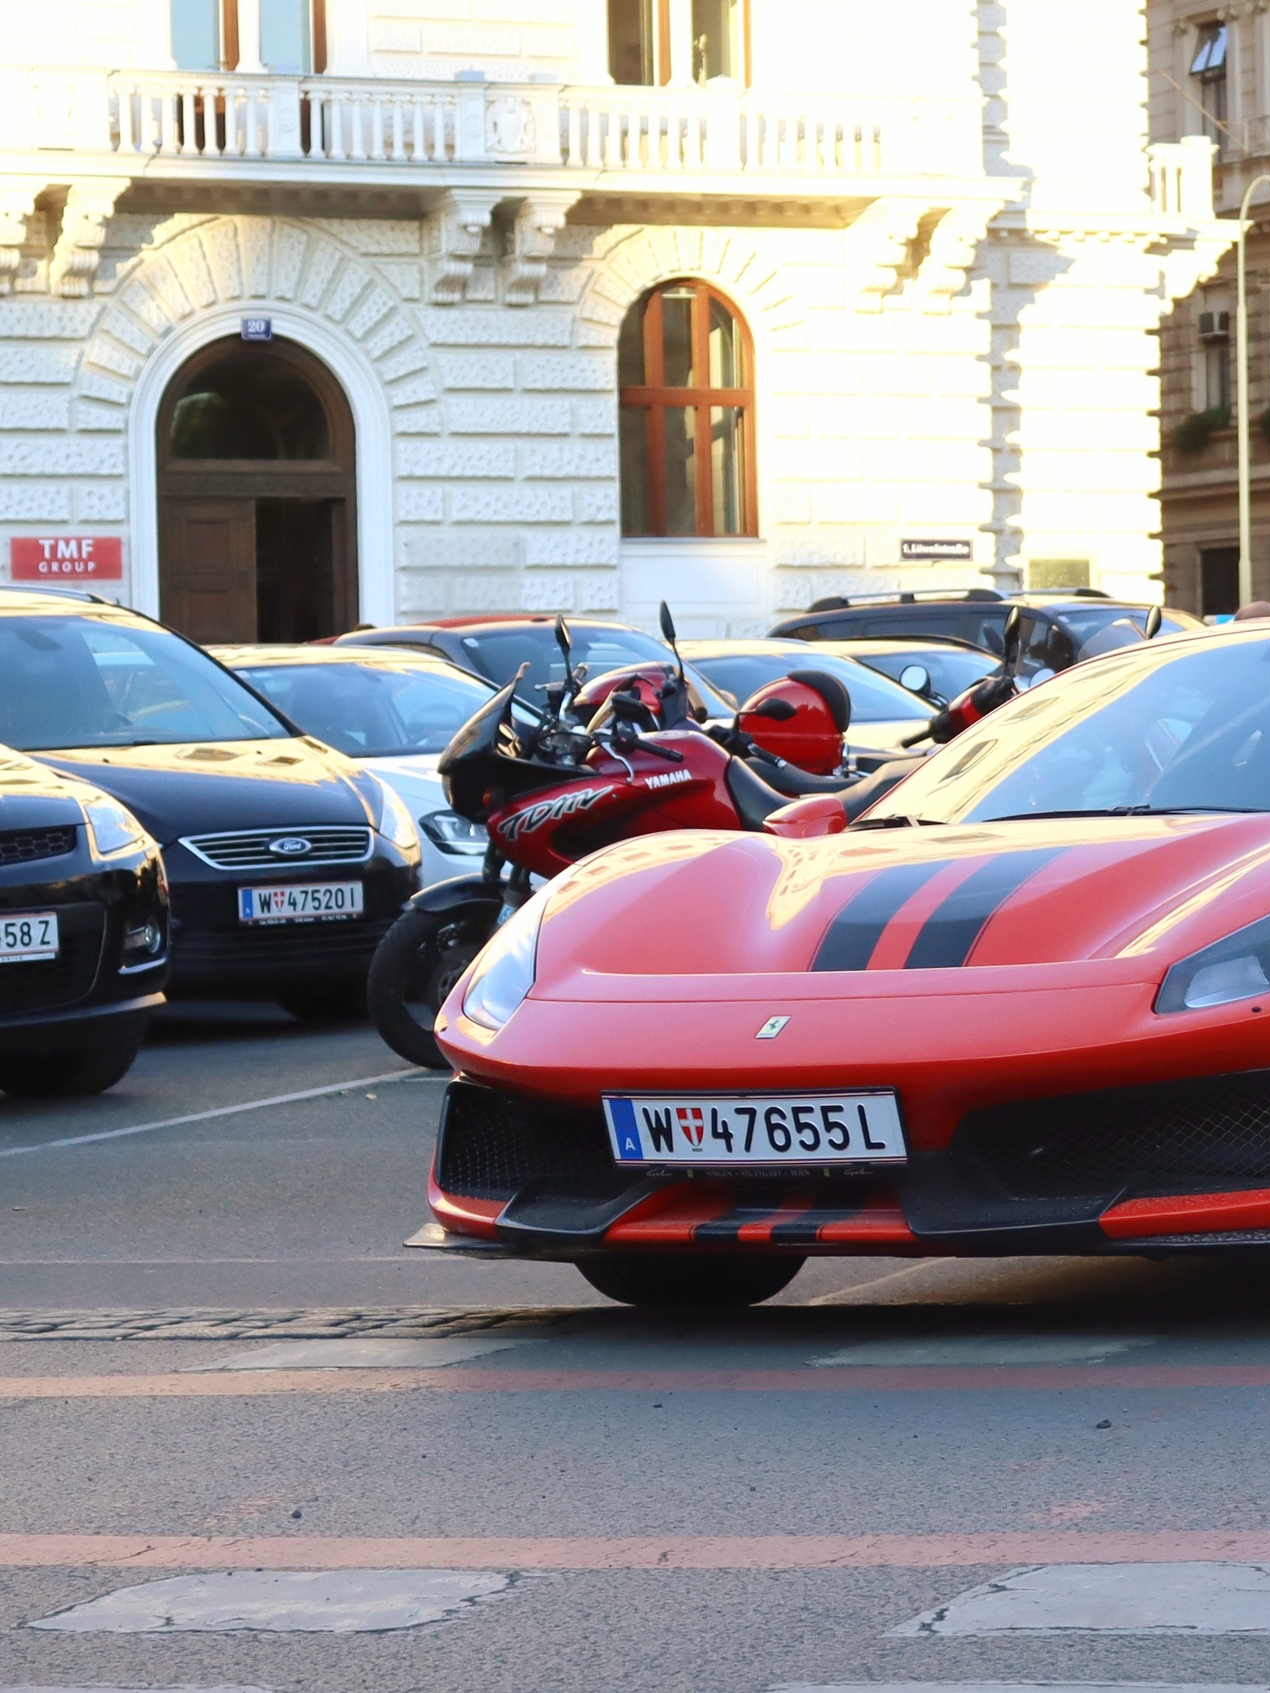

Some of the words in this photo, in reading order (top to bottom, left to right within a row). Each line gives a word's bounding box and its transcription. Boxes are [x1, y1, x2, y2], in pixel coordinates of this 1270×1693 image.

[247, 320, 265, 333] 20
[38, 539, 94, 559] TMF
[38, 561, 96, 573] GROUP
[645, 769, 692, 789] YAMAHA
[258, 891, 272, 914] W
[0, 921, 32, 948] 58
[625, 1137, 636, 1151] A
[642, 1106, 675, 1153] W
